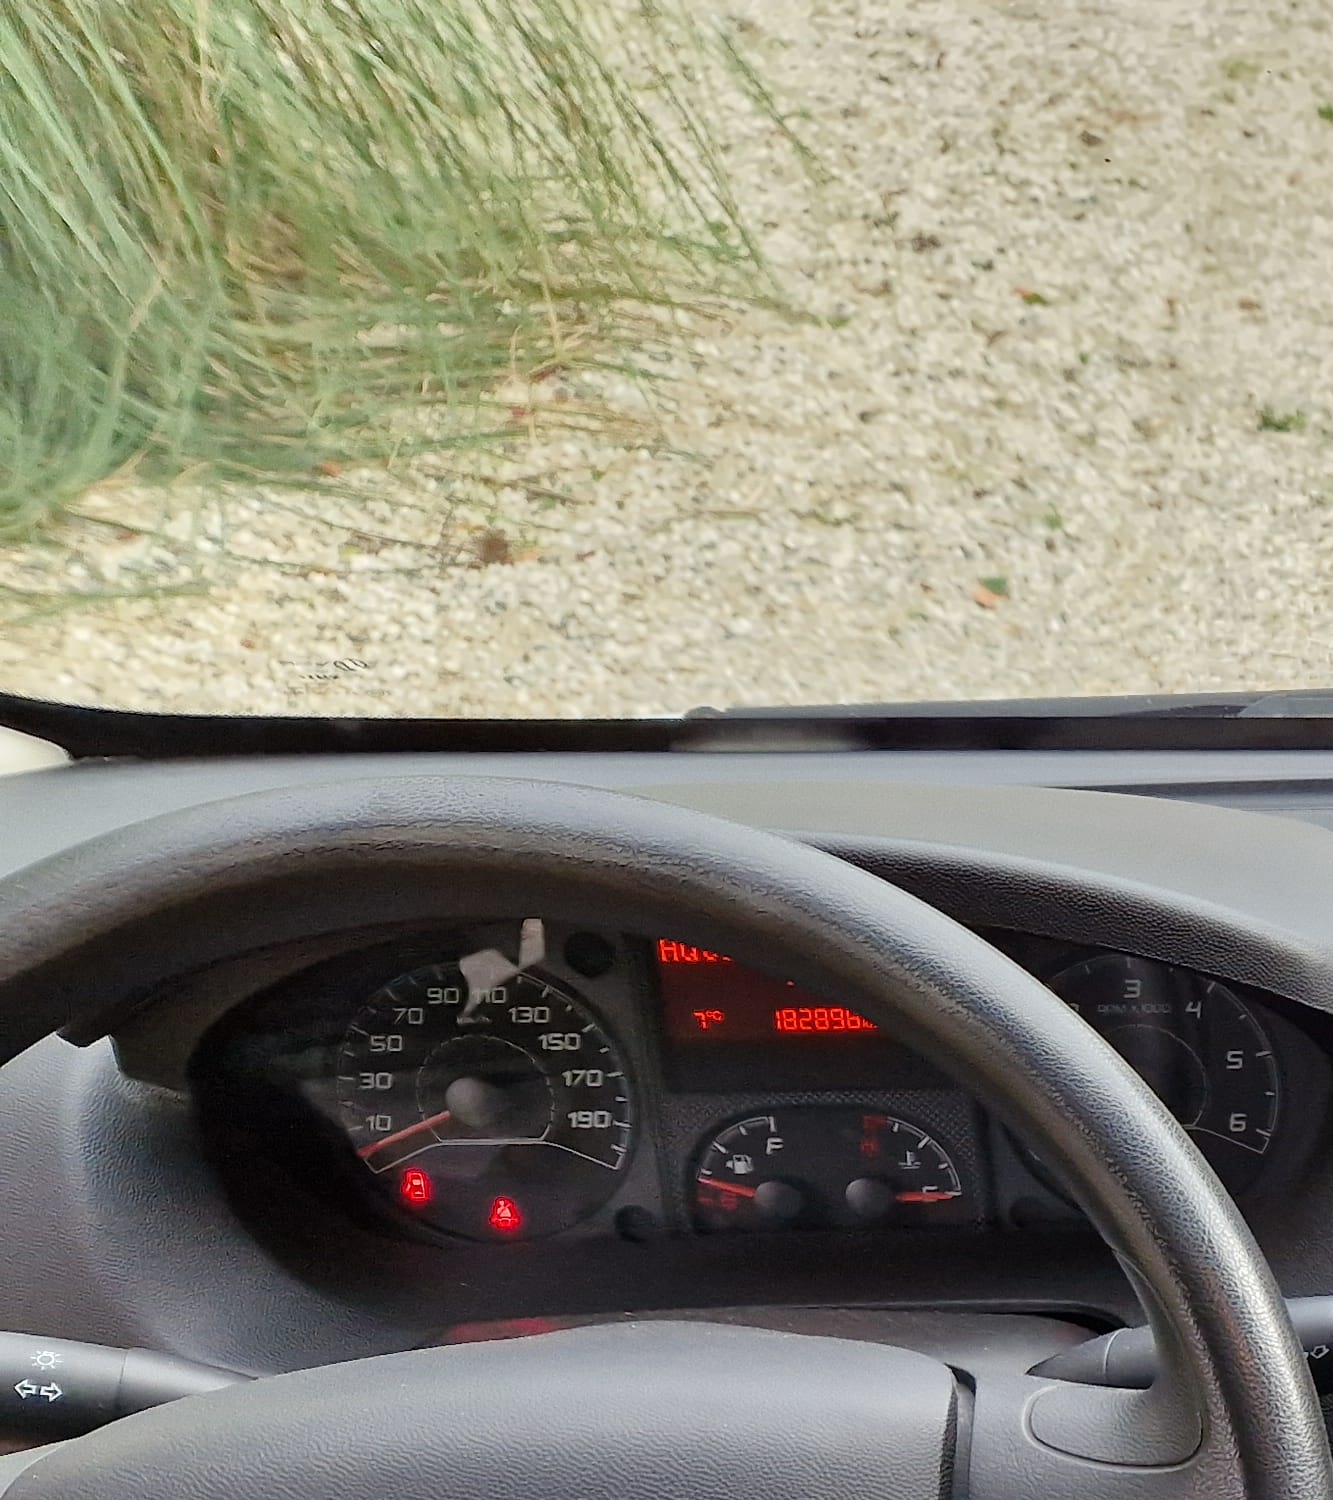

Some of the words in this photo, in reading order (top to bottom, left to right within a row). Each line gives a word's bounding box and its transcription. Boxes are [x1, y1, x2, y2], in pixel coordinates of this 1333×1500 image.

[427, 987, 460, 1005] 90
[1123, 979, 1141, 998] 3
[393, 1008, 424, 1025] 70
[508, 1007, 550, 1024] 130
[1185, 1001, 1202, 1019] 4
[369, 1034, 403, 1052] 50
[538, 1033, 581, 1051] 150
[1226, 1050, 1244, 1069] 5
[359, 1072, 393, 1090] 30
[562, 1069, 603, 1087] 170
[366, 1115, 392, 1132] 10
[568, 1110, 612, 1128] 190
[1230, 1113, 1247, 1132] 6
[766, 1137, 785, 1155] F
